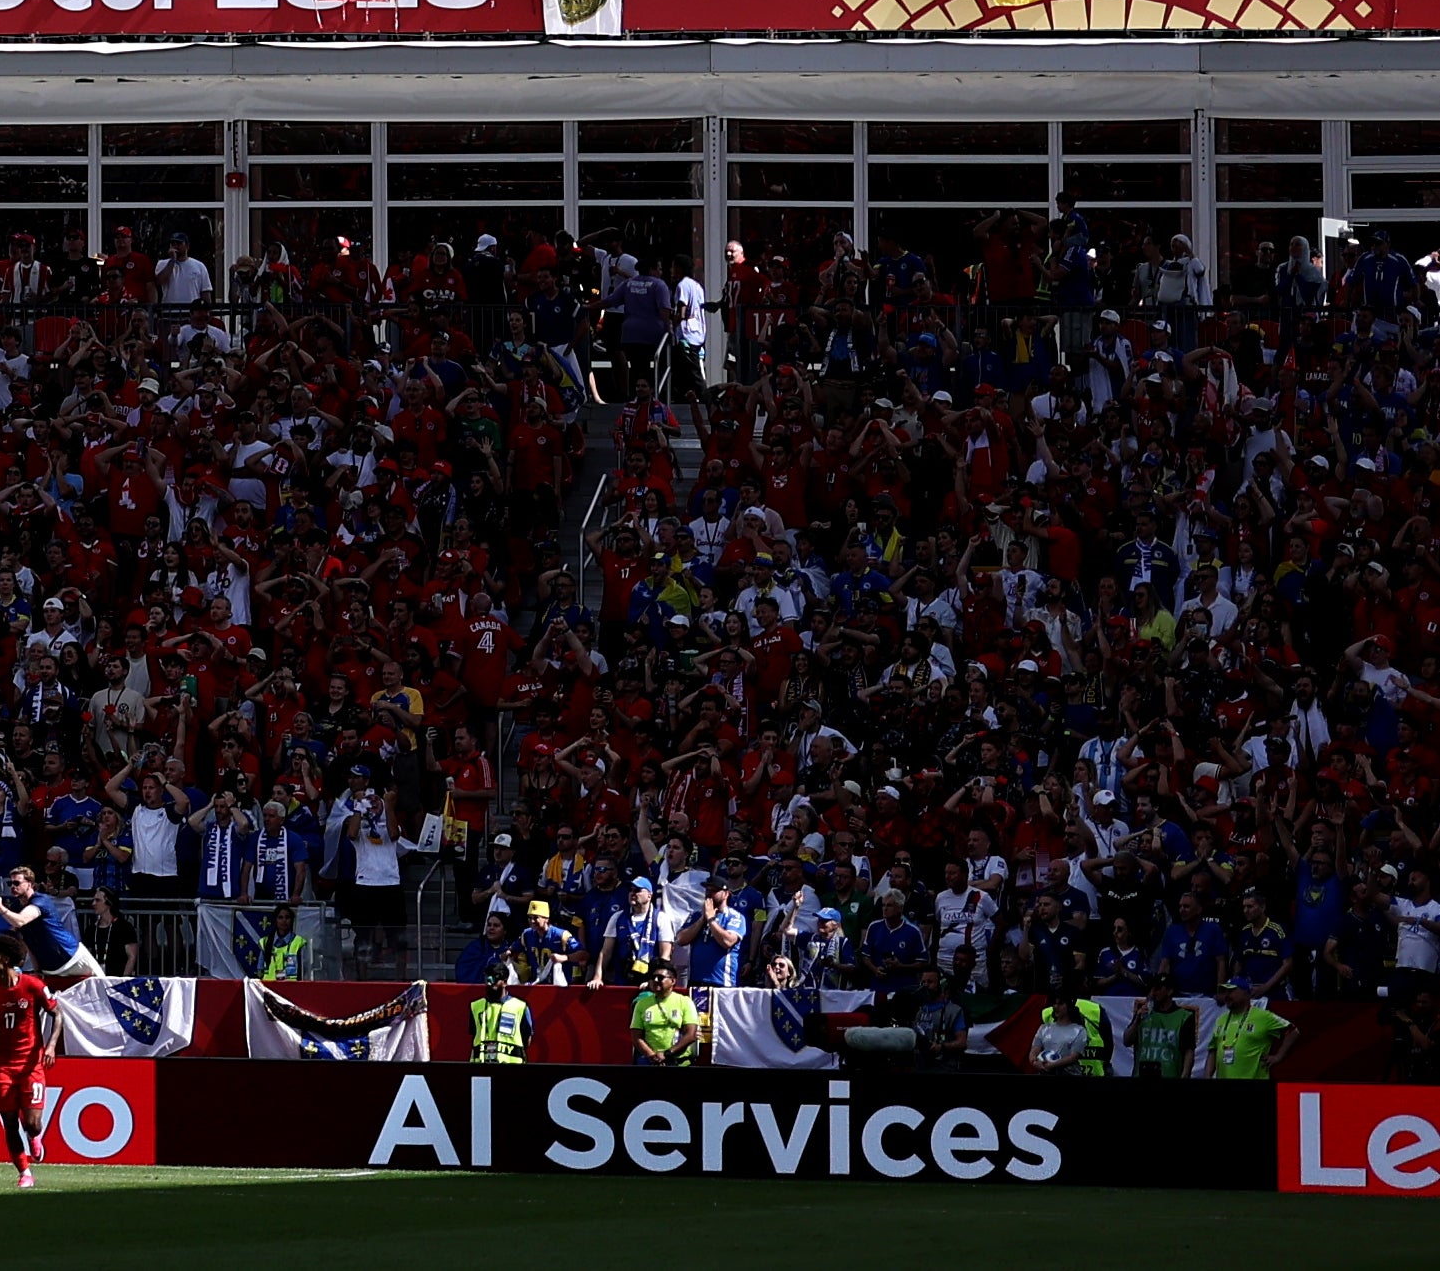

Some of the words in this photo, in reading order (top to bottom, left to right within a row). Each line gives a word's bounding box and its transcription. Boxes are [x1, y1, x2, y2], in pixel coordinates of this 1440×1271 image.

[621, 568, 630, 578] 17
[469, 620, 503, 632] CANADA
[477, 631, 495, 654] 4
[4, 1013, 17, 1030] 17
[368, 1075, 492, 1167] AI
[546, 1077, 1062, 1182] Services
